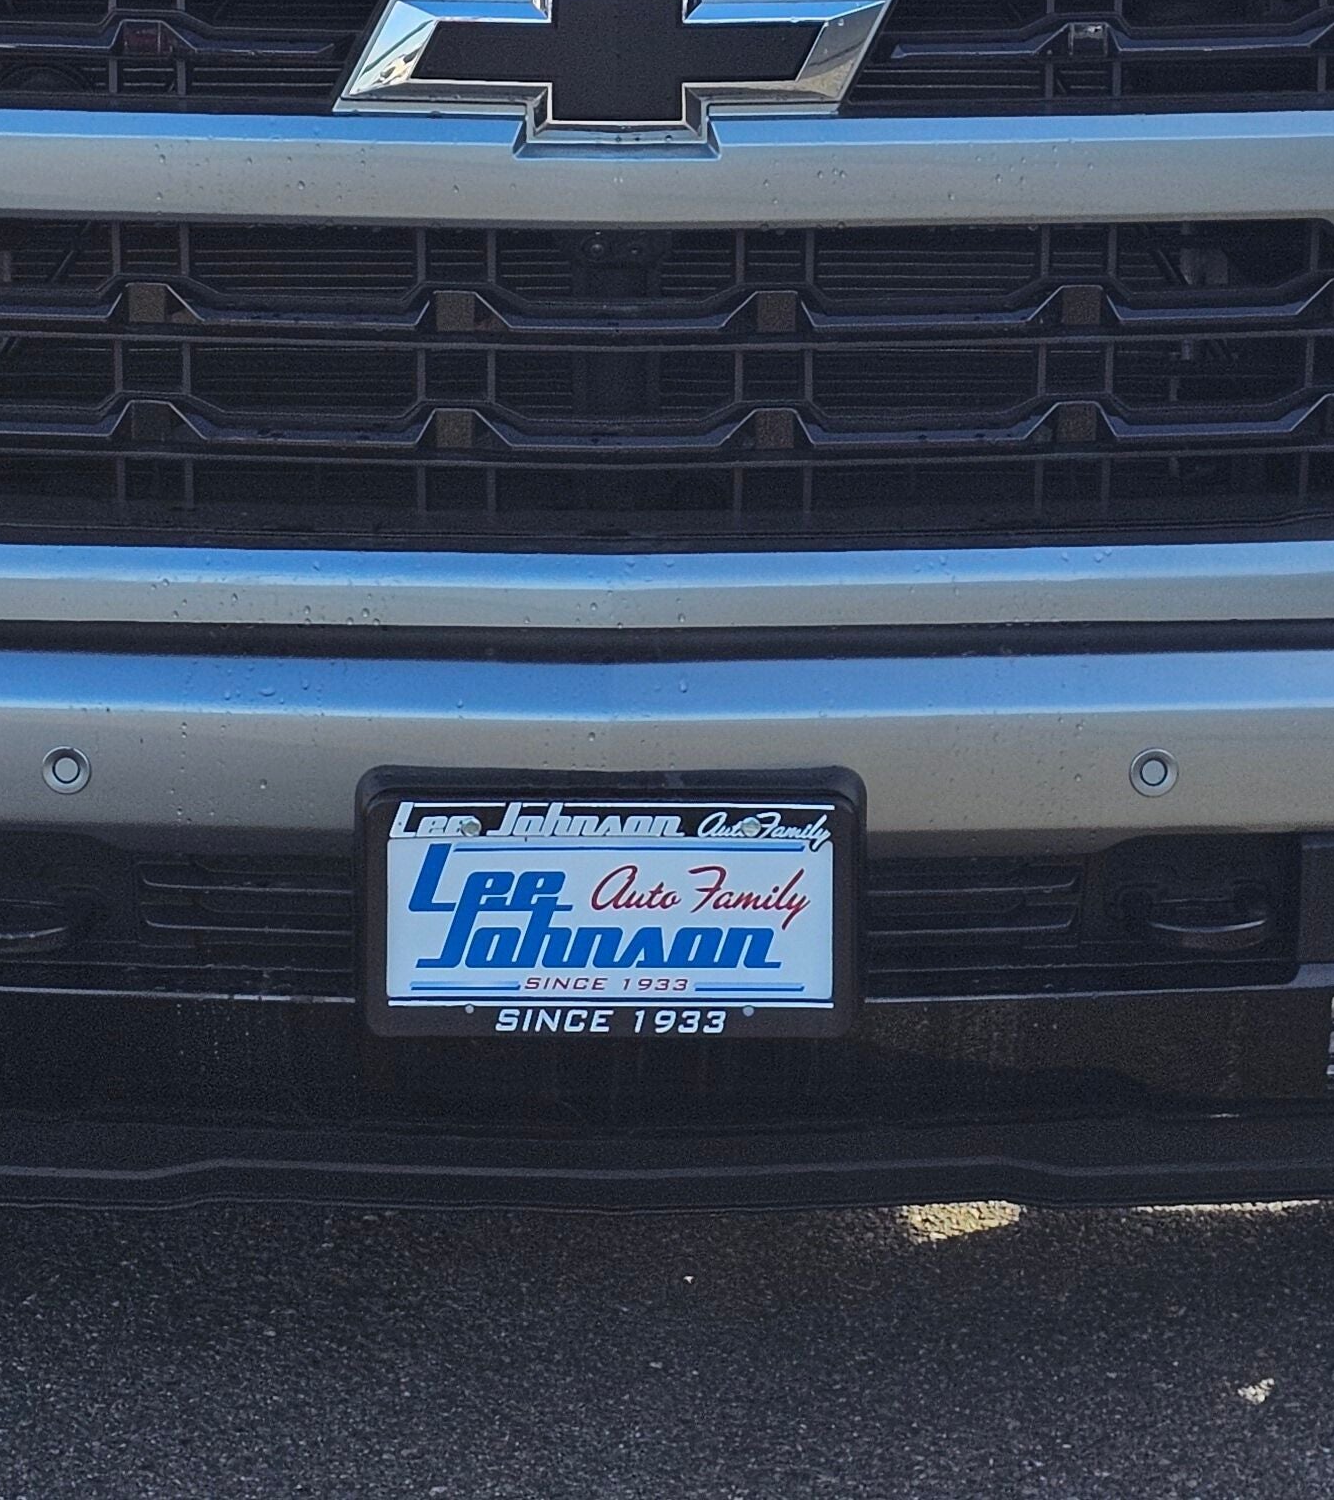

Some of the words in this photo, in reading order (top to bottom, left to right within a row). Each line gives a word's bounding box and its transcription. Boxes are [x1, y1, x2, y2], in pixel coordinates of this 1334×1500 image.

[486, 802, 685, 837] Johnson
[697, 811, 761, 838] Aut
[755, 811, 832, 850] Family
[408, 843, 573, 912] Lee
[591, 865, 682, 910] Auto
[688, 865, 811, 930] Family
[415, 896, 783, 969] Johnson
[524, 977, 608, 991] SINCE
[623, 978, 688, 992] 1933
[495, 1008, 614, 1033] SINCE
[634, 1010, 727, 1034] 1933
